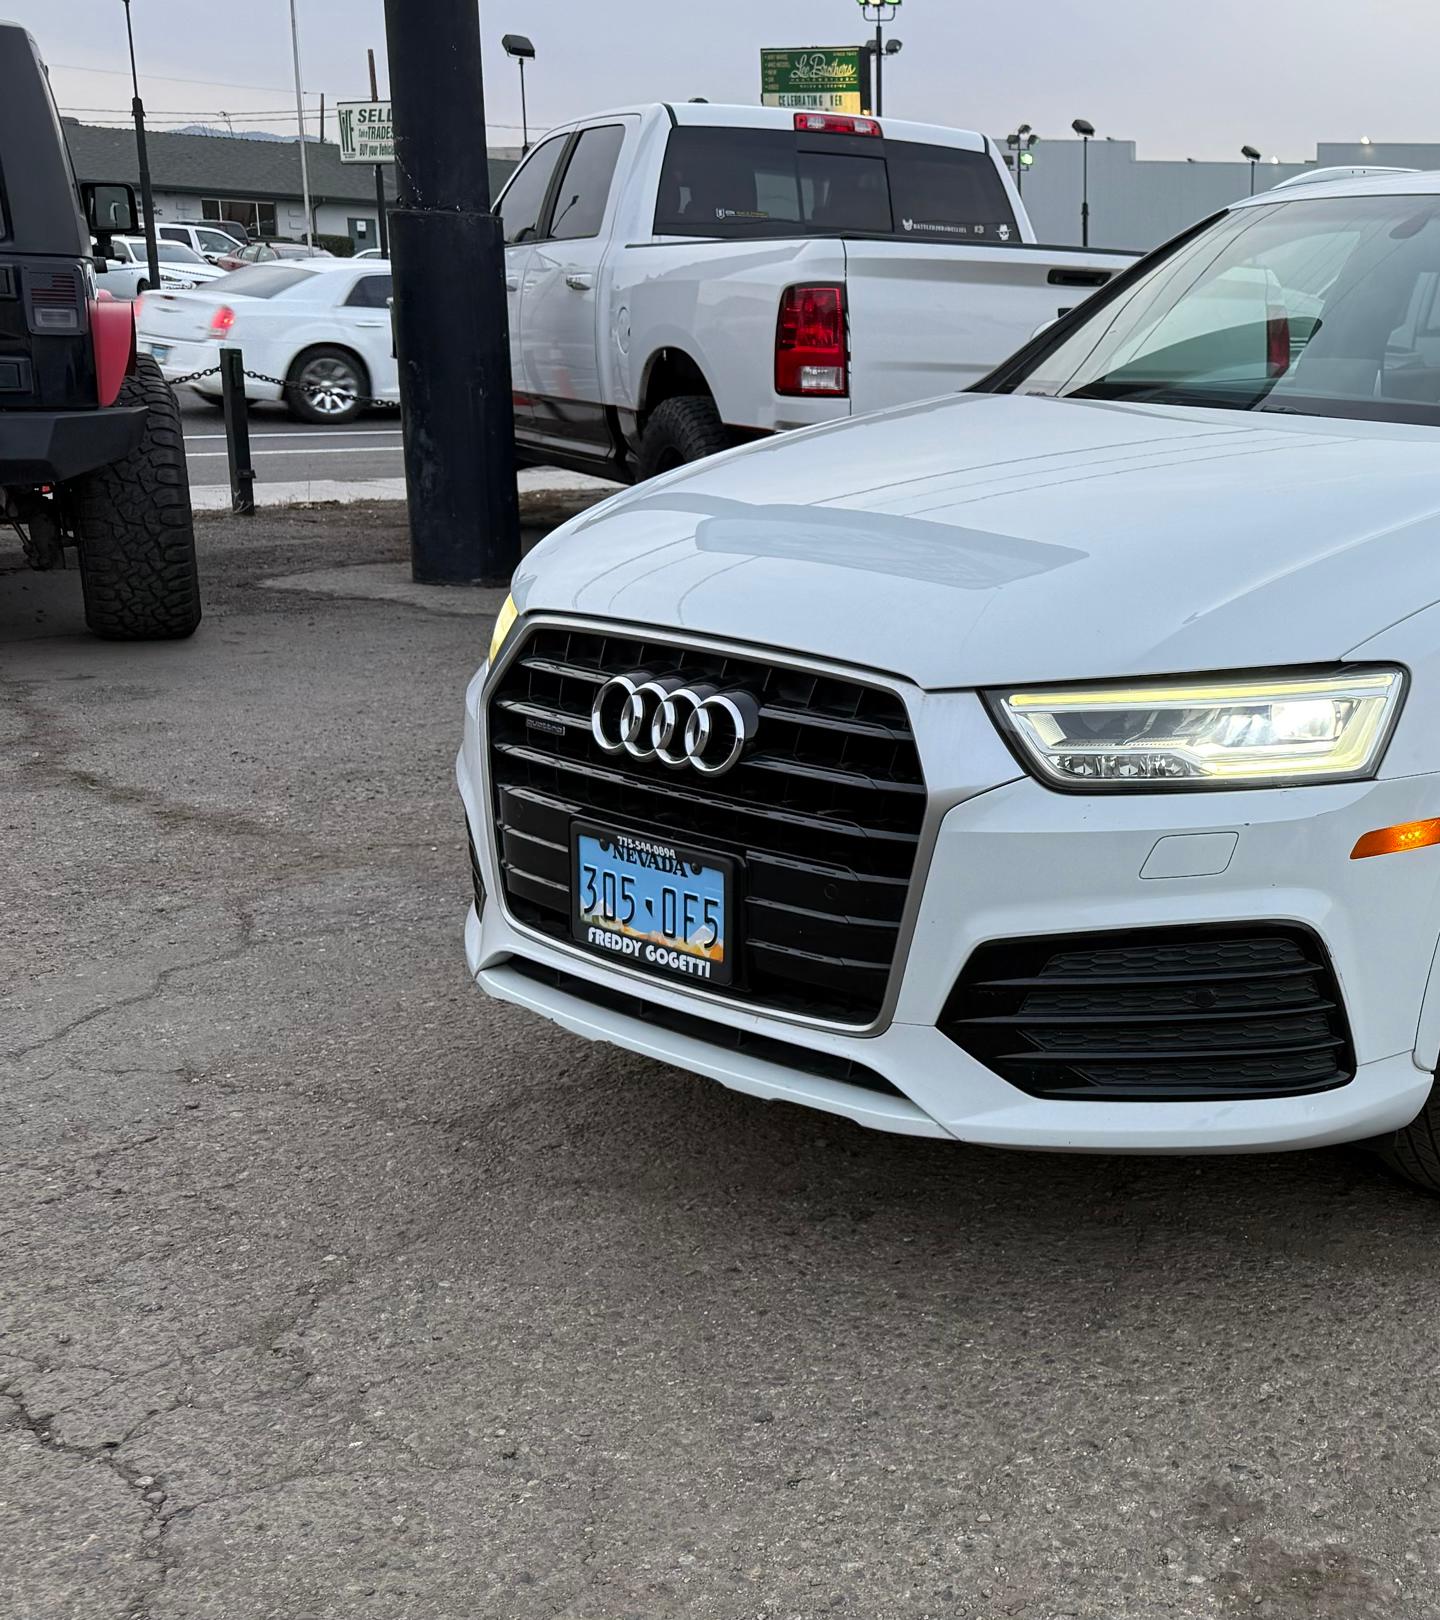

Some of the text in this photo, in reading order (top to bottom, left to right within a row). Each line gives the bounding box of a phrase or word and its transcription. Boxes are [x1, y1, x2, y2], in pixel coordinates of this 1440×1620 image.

[810, 53, 857, 78] Brothers
[613, 845, 689, 878] NEVADA
[588, 926, 712, 979] FREDDY GOGETTI
